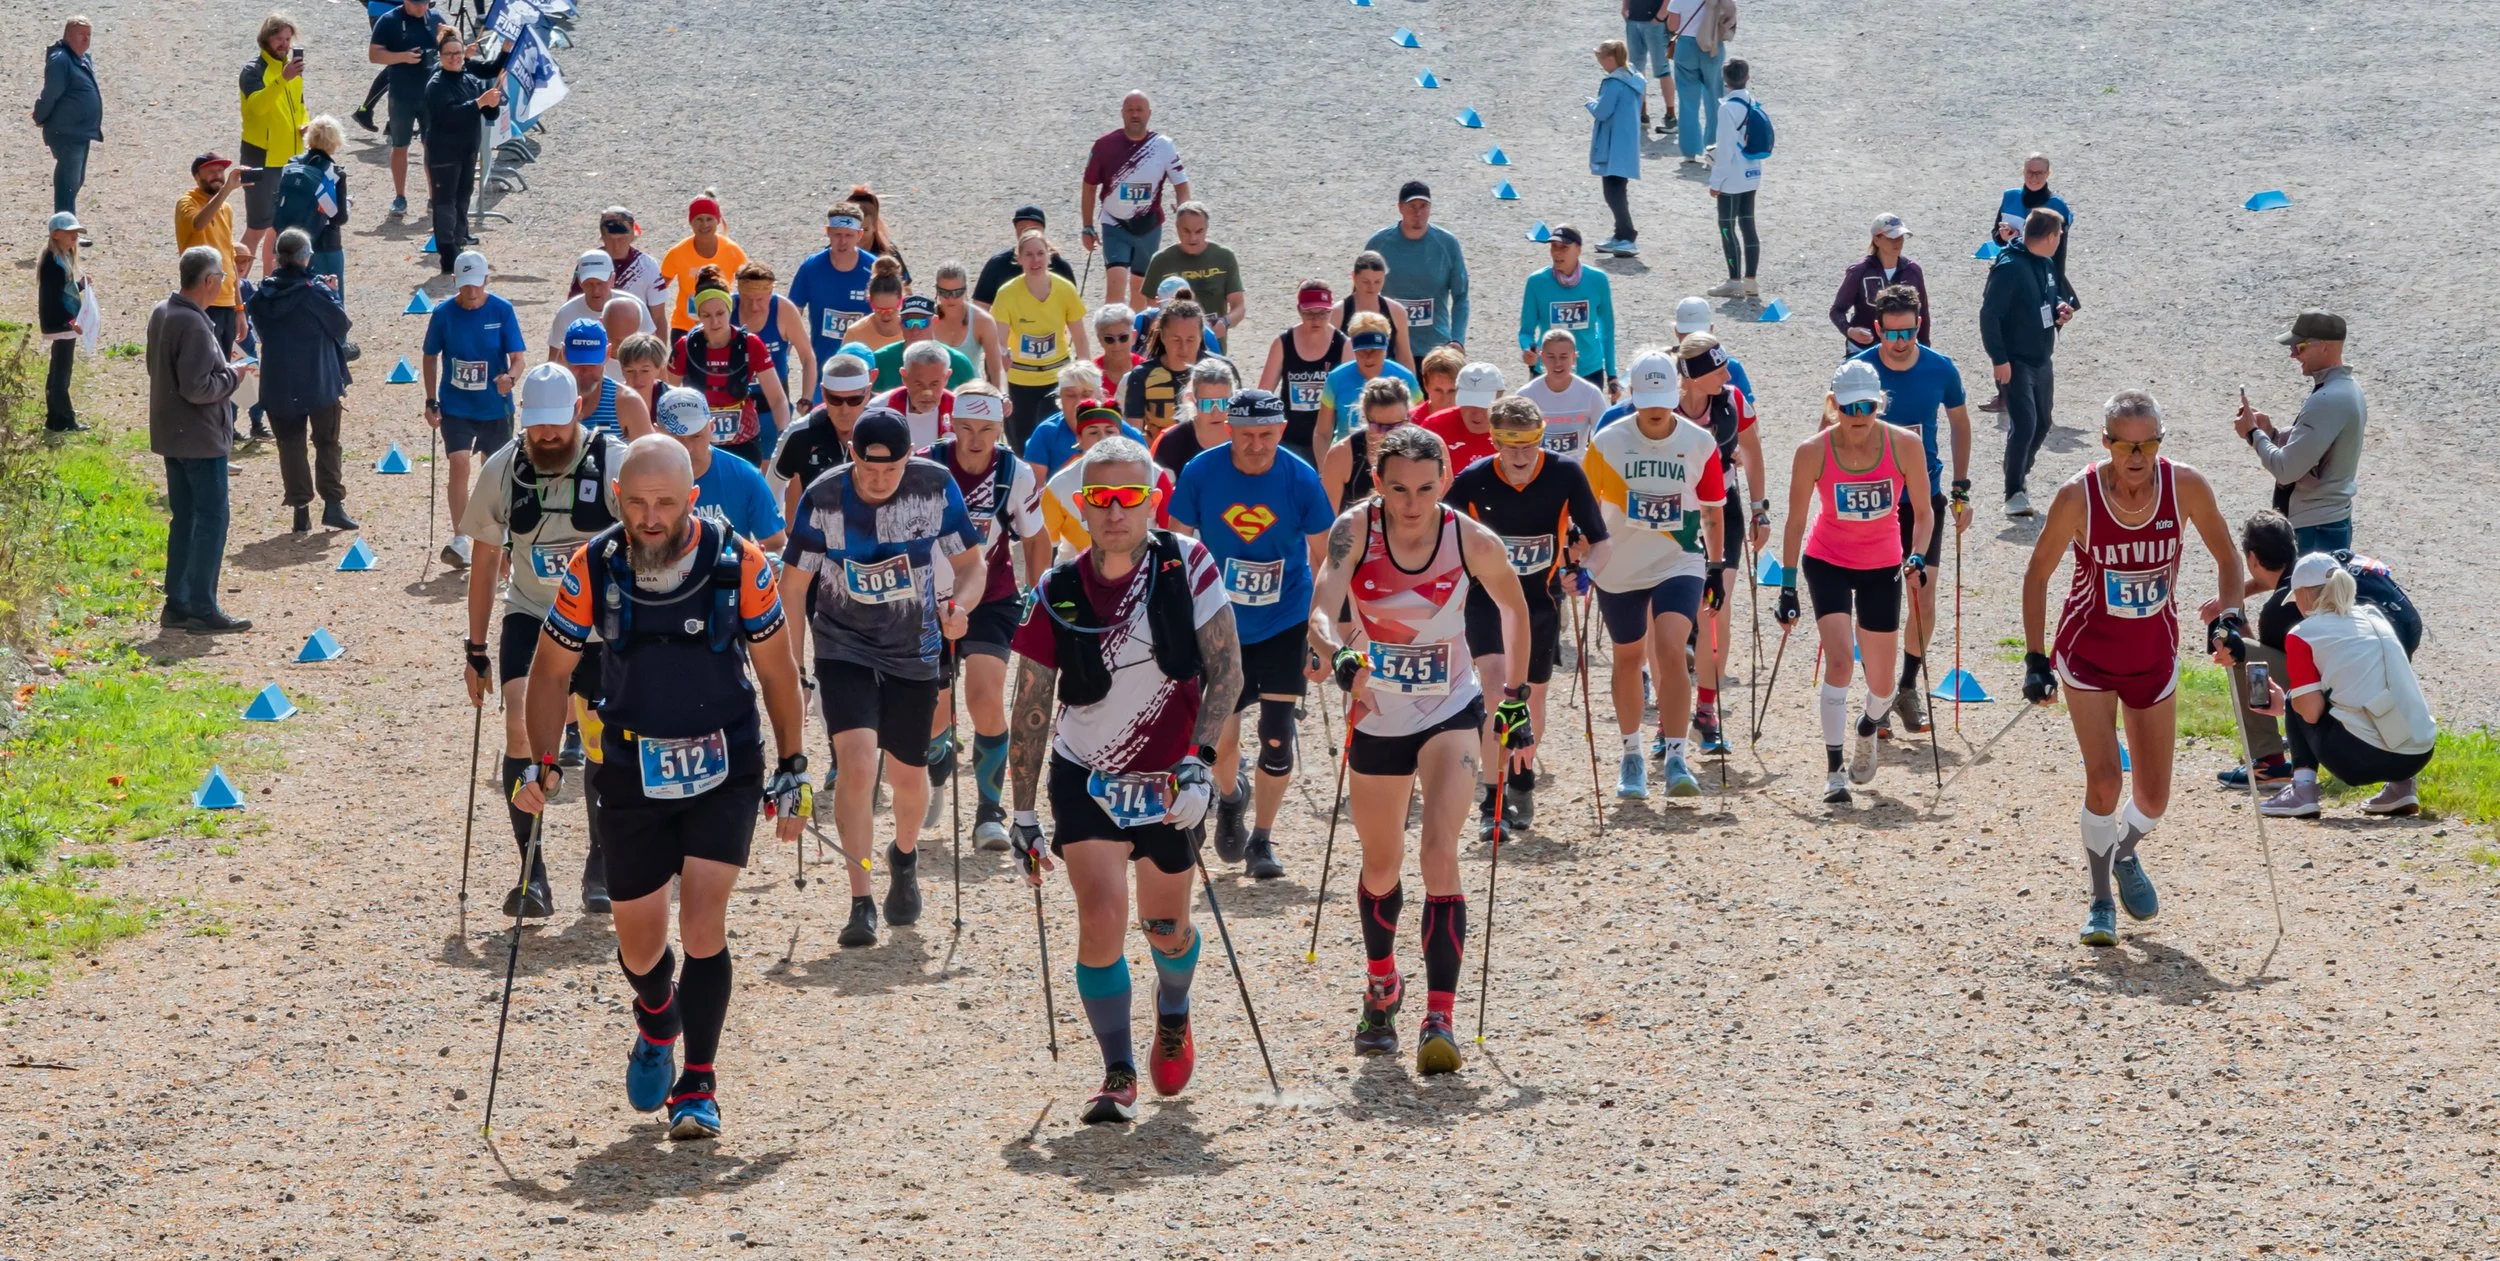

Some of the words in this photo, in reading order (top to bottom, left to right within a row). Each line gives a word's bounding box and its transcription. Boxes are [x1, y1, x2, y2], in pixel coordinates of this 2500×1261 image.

[1127, 188, 1145, 199] 517
[1406, 306, 1425, 319] 23
[1557, 308, 1582, 322] 524
[572, 338, 601, 346] ESTONIA
[1028, 341, 1049, 353] 510
[455, 368, 479, 381] 548
[1288, 371, 1328, 382] bodyAR
[669, 402, 699, 411] ESTONIA
[1544, 439, 1570, 451] 535
[1625, 460, 1686, 483] LIETUVA
[1847, 490, 1881, 509] 550
[693, 503, 723, 518] ONIA
[1637, 501, 1670, 520] 543
[1505, 544, 1540, 564] 547
[2092, 538, 2177, 566] LATVIJA
[543, 554, 568, 575] 53
[857, 568, 897, 592] 508
[1235, 571, 1272, 592] 538
[2120, 581, 2158, 604] 516
[544, 620, 583, 648] OTOR
[1382, 655, 1432, 681] 545
[660, 746, 708, 779] 512
[1105, 782, 1147, 813] 514
